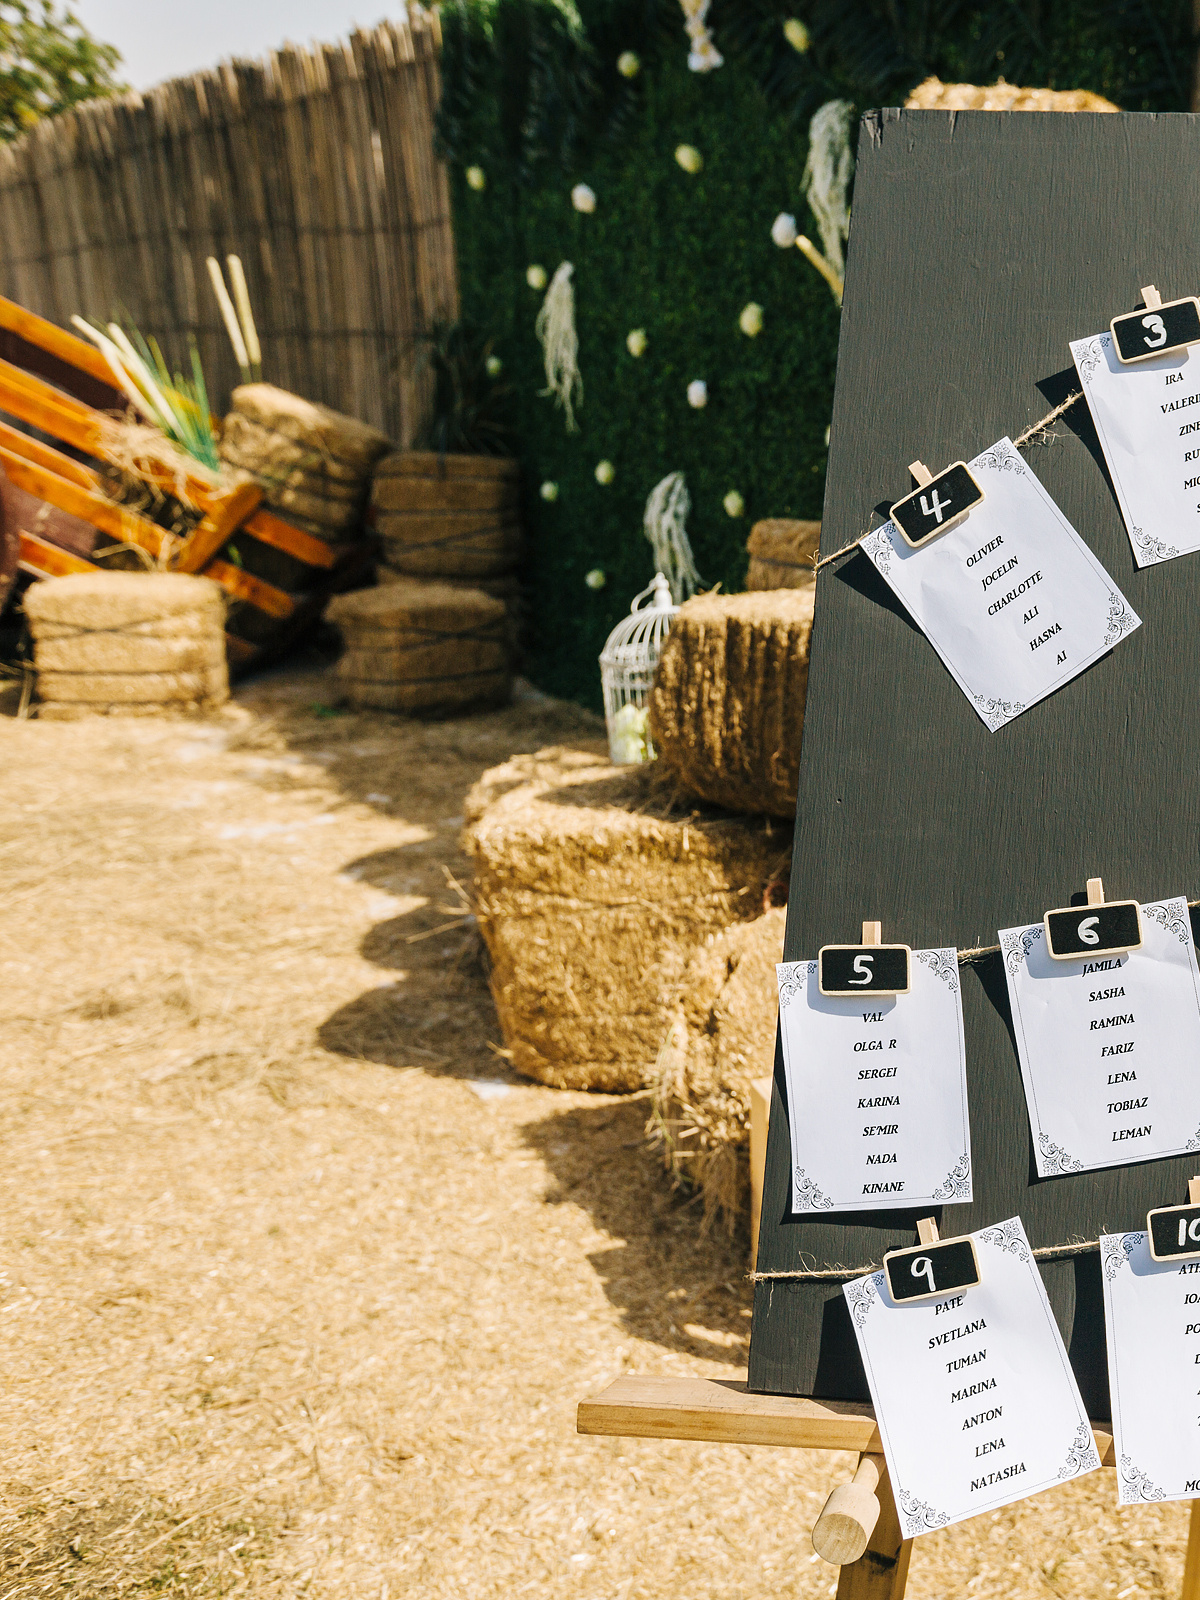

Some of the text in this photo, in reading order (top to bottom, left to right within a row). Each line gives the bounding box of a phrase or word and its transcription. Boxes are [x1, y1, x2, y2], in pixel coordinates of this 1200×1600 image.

[1141, 314, 1168, 348] 3
[1165, 372, 1184, 385] IRA
[919, 488, 952, 523] 4
[965, 534, 1004, 568] OLIVIER
[981, 556, 1019, 591] JOCELIN
[987, 571, 1043, 617] CHARLOTTE
[1022, 606, 1040, 624] ALI
[1029, 622, 1062, 651] HASNA
[1055, 650, 1068, 665] AI
[1077, 916, 1100, 945] 6
[847, 954, 874, 986] 5
[1082, 958, 1123, 977] JAMILA
[1088, 986, 1126, 1002] SASHA
[862, 1011, 884, 1023] VAL
[1089, 1013, 1135, 1031] RAMINA
[853, 1039, 897, 1053] OLGA R
[1100, 1041, 1135, 1057] FARIZ
[857, 1067, 897, 1080] SERGEI
[1107, 1070, 1137, 1085] LENA
[857, 1095, 900, 1109] KARINA
[1107, 1097, 1148, 1114] TOBIAZ
[1111, 1125, 1152, 1142] LEMAN
[865, 1153, 898, 1165] NADA
[861, 1181, 905, 1195] KINANE
[910, 1256, 936, 1292] 9
[935, 1295, 964, 1316] PATE
[928, 1318, 987, 1350] SVETLANA
[945, 1349, 987, 1374] TUMAN
[950, 1377, 998, 1403] MARINA
[962, 1406, 1003, 1431] ANTON
[974, 1437, 1006, 1458] LENA
[970, 1462, 1027, 1492] NATASHA
